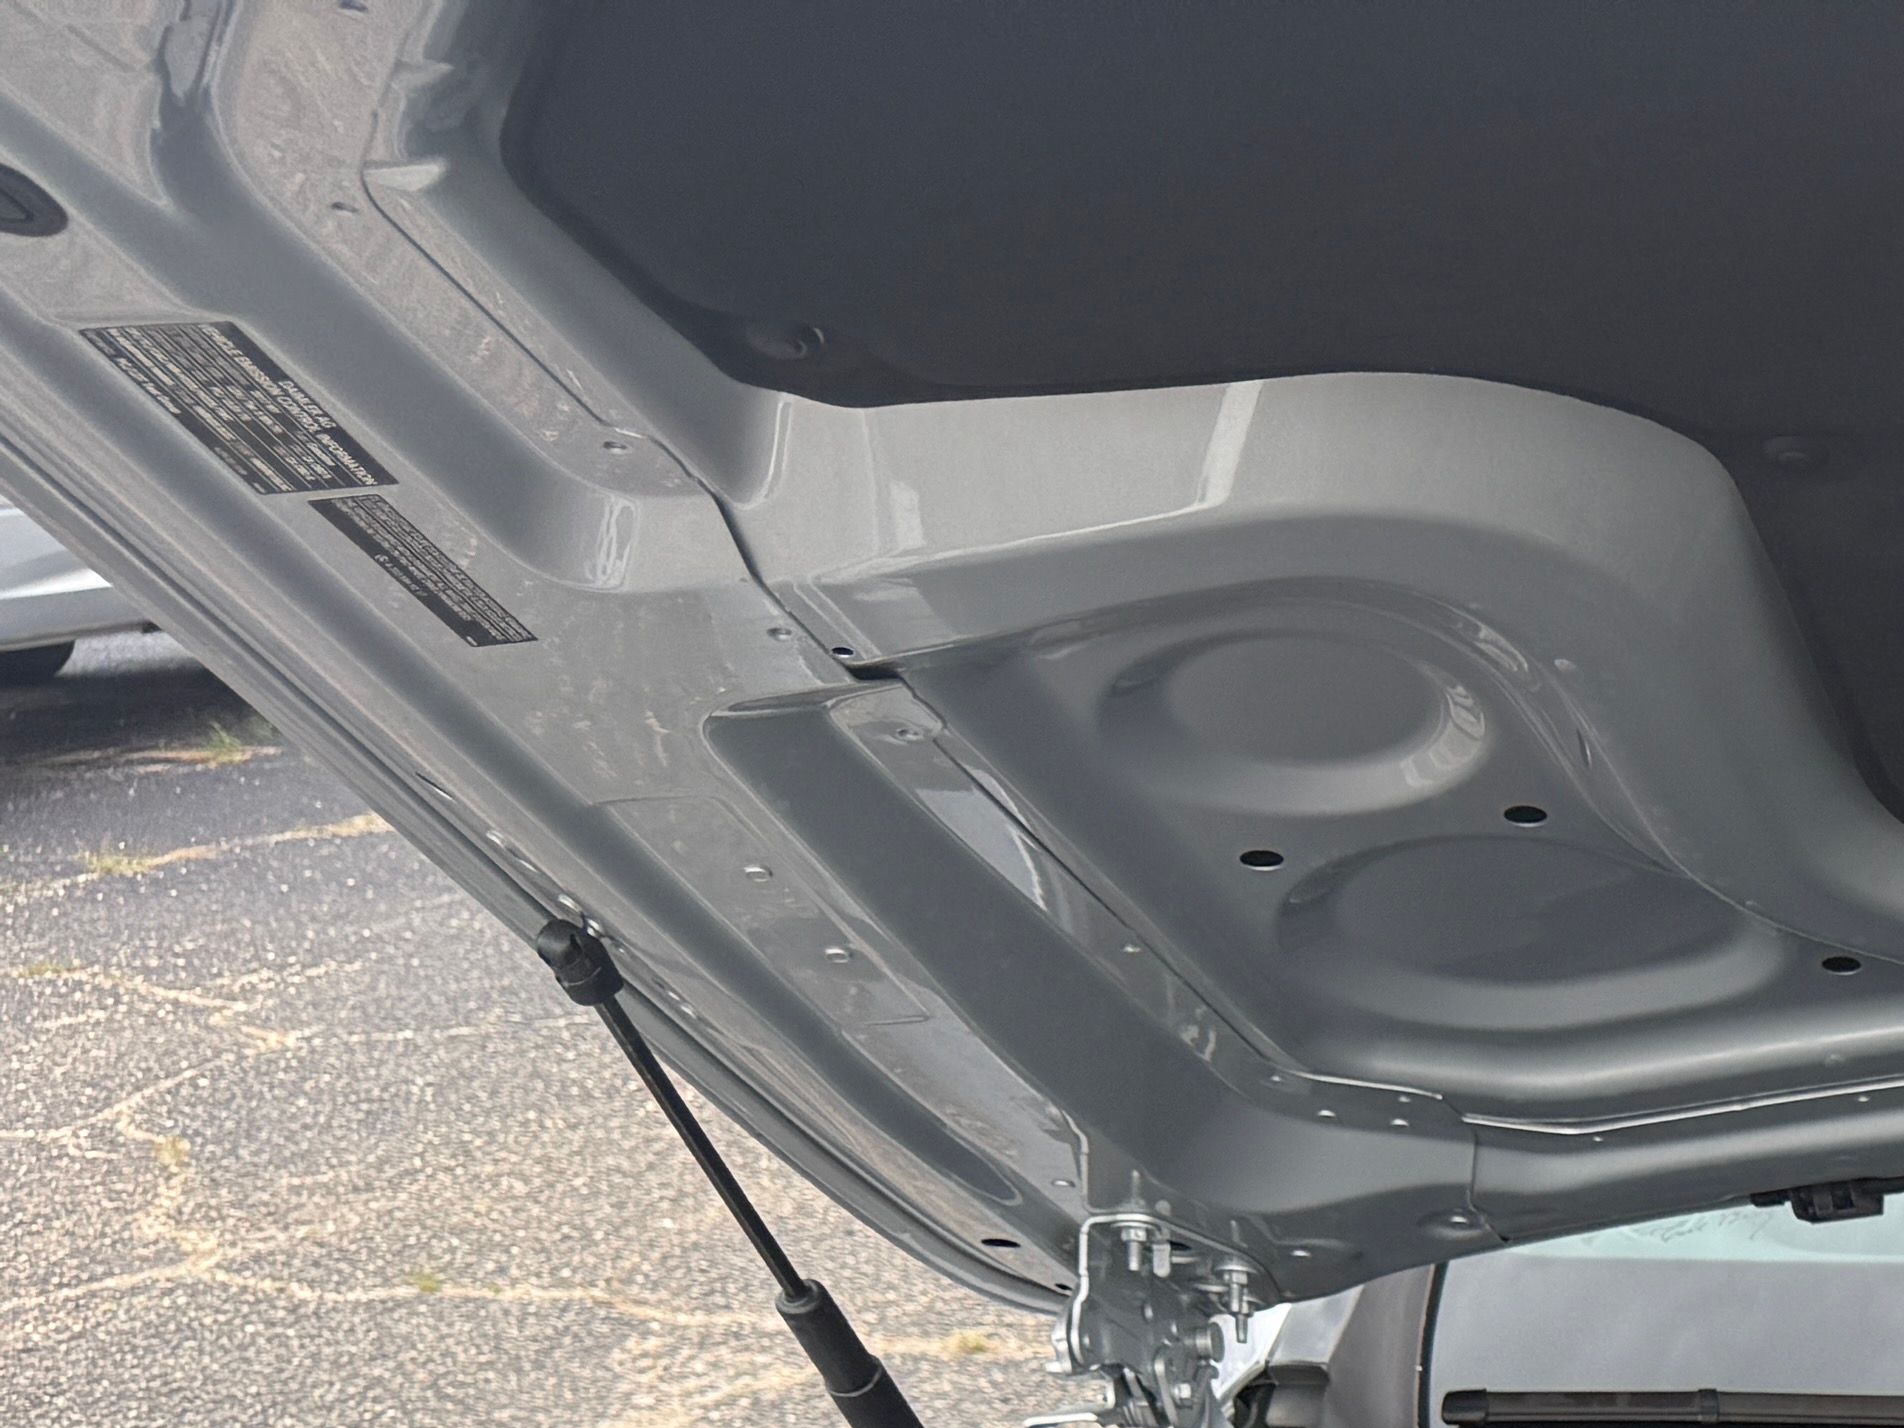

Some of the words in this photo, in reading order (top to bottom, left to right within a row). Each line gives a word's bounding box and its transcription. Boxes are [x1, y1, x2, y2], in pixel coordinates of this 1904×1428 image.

[195, 323, 244, 356] VEHICLE
[230, 356, 285, 395] EMISSION
[272, 395, 323, 431] CONTROL
[312, 433, 379, 484] INFORMATION
